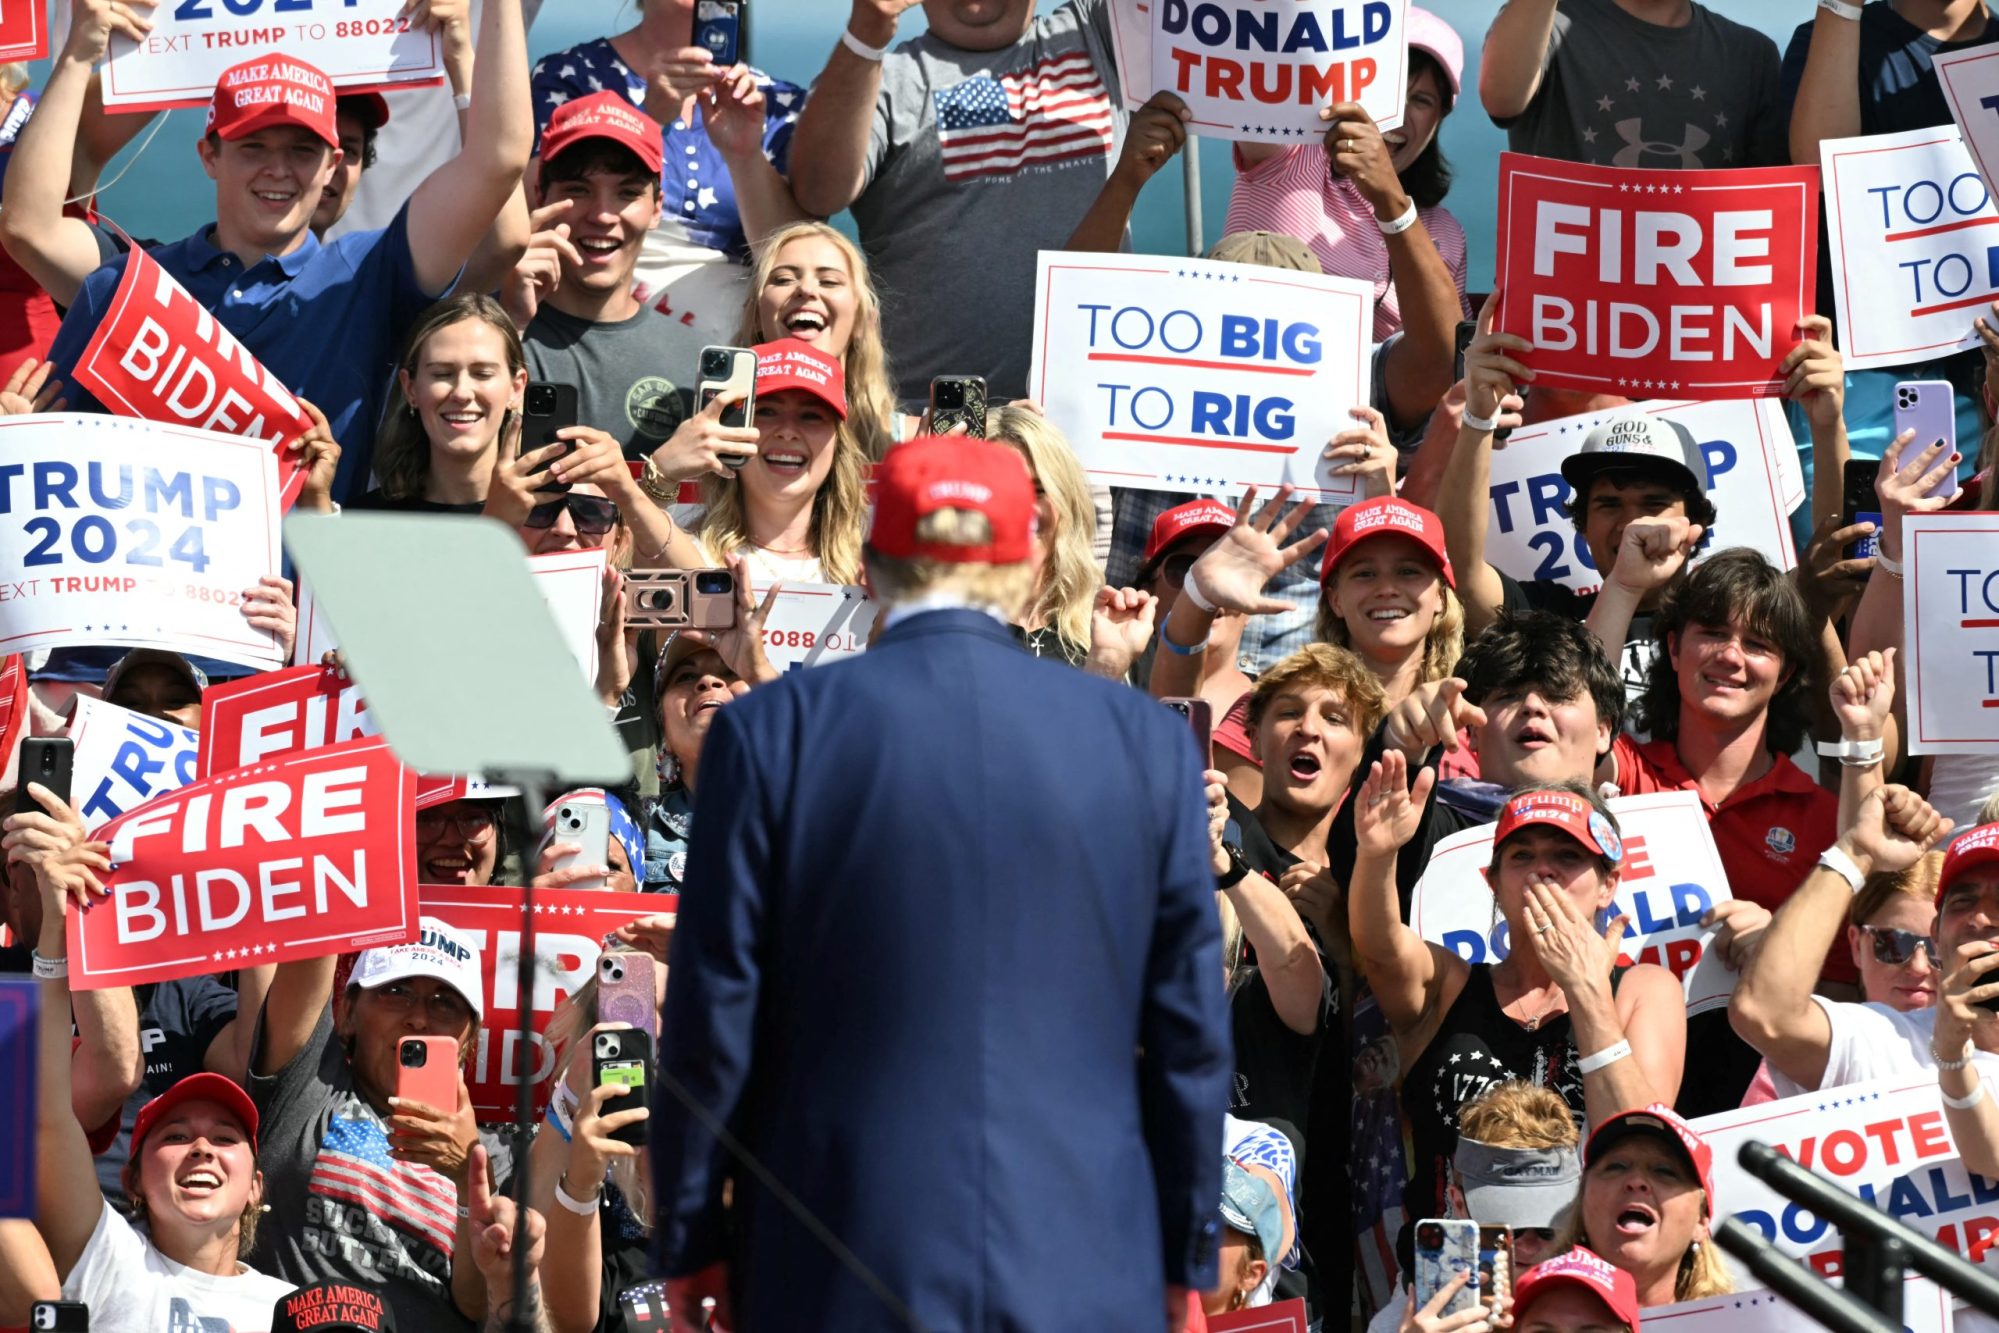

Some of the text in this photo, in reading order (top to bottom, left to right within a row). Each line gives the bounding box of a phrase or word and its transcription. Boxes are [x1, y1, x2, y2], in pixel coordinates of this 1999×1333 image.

[202, 27, 286, 49] TRUMP
[295, 23, 326, 41] TO
[335, 17, 411, 38] 88022
[1162, 0, 1392, 53] DONALD
[227, 62, 331, 95] MAKE AMERICA
[1171, 46, 1378, 105] TRUMP
[234, 85, 325, 114] GREAT AGAIN
[597, 104, 645, 133] AMERICA
[606, 116, 643, 137] AGAIN
[985, 176, 1013, 185] HOME
[1034, 166, 1053, 174] THE
[1059, 158, 1095, 170] BRAVE
[1867, 172, 1990, 229] TOO
[1532, 200, 1773, 287] FIRE
[1899, 253, 1973, 303] TO
[1078, 304, 1322, 365] TOO BIG
[1532, 294, 1773, 361] BIDEN
[758, 352, 833, 378] AKE AMERICA
[795, 366, 827, 386] AGAIN
[632, 381, 653, 400] SAN
[1097, 383, 1296, 441] TO RIG
[1612, 420, 1647, 435] GOD
[0, 461, 241, 522] TRUMP
[1490, 440, 1738, 534] TRP
[1173, 507, 1203, 521] MAKE
[1180, 514, 1211, 527] GREAT
[1354, 514, 1424, 533] GREAT AGAIN
[1355, 504, 1424, 523] MAKE AMERICA
[23, 514, 211, 573] 2024
[50, 576, 137, 594] TRUMP
[825, 633, 856, 652] TO
[239, 686, 373, 768] FIR
[110, 765, 369, 863] FIRE
[1514, 794, 1584, 814] Trump
[1523, 809, 1570, 823] 2024
[114, 848, 369, 945] BIDEN
[1442, 883, 1712, 964] DALD
[411, 952, 443, 966] 2024
[146, 1062, 173, 1074] AIN!
[1770, 1110, 1952, 1176] VOTE
[306, 1196, 388, 1243] SUCK
[287, 1284, 384, 1317] MAKE AMERICA
[296, 1303, 380, 1331] GREAT AGAIN
